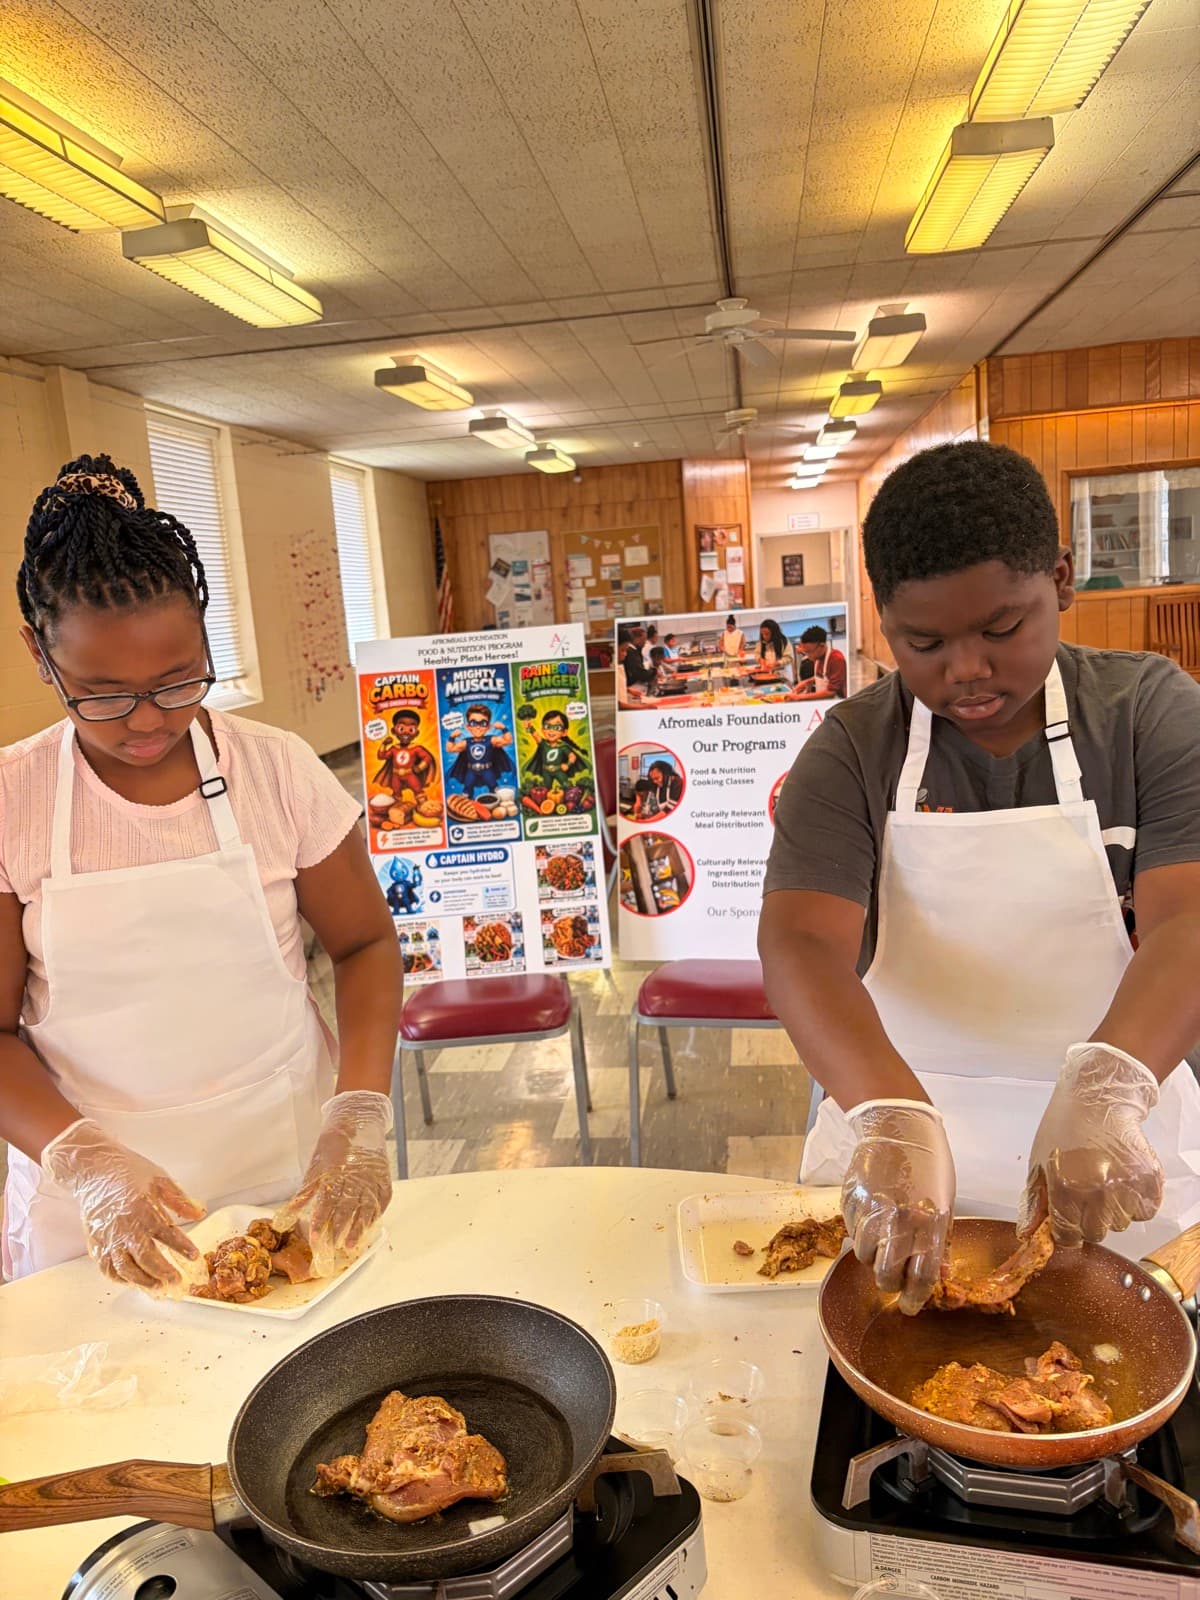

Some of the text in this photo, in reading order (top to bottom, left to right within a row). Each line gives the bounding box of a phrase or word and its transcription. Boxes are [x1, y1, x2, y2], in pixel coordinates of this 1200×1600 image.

[468, 633, 508, 642] FOUNDATION
[418, 648, 439, 656] FOOD
[447, 644, 486, 654] NUTRITION
[488, 641, 523, 650] PROGRAM
[424, 651, 519, 665] Healthy Plate Heroes!
[453, 668, 496, 681] MIGHTY
[520, 662, 580, 680] RAINBOW
[375, 674, 420, 687] CAPTAIN
[521, 674, 579, 694] RANGER
[369, 683, 429, 703] CARBO
[445, 678, 506, 697] MUSCLE
[658, 712, 800, 729] Afromeals Foundation
[692, 739, 786, 754] Our Programs
[719, 766, 756, 774] Nutrition
[692, 779, 724, 787] Cooking
[690, 809, 766, 819] Culturally Relevant
[440, 850, 505, 865] CAPTAIN HYDRO
[697, 858, 735, 867] Culturally
[707, 869, 749, 878] Ingredient
[712, 880, 760, 888] Distribution
[707, 907, 727, 917] Our
[880, 1565, 902, 1574] DANGER
[930, 1574, 951, 1582] CARBON
[979, 1581, 1000, 1590] HAZARD
